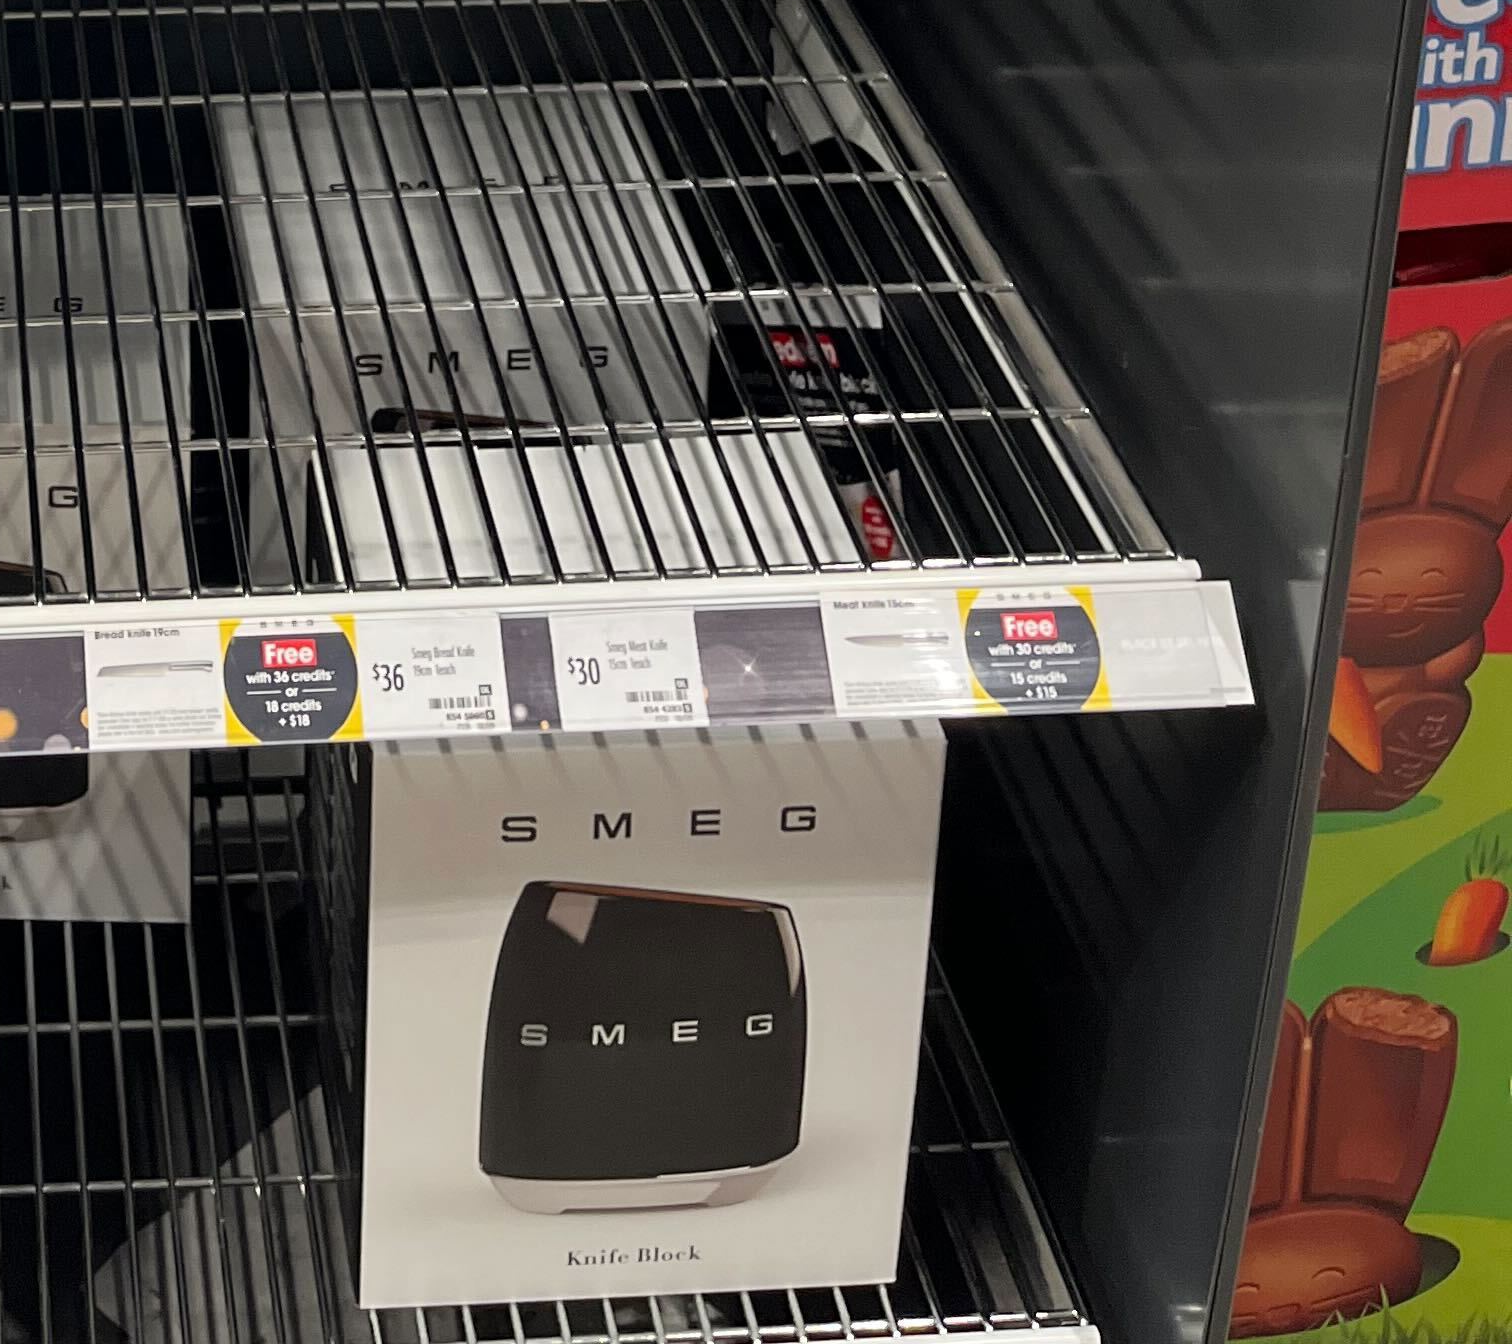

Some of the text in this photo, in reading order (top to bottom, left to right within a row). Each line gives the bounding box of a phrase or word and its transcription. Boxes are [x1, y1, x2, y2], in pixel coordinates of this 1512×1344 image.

[1423, 31, 1499, 85] ith
[94, 629, 125, 640] Bread
[126, 628, 152, 639] knife
[1004, 614, 1055, 638] Free
[264, 642, 315, 666] Free
[988, 644, 1015, 657] with
[1017, 644, 1031, 656] 30
[245, 672, 272, 685] with
[274, 671, 289, 683] 36
[372, 663, 404, 692] $36
[568, 657, 600, 685] $30
[1011, 671, 1067, 684] 15 credits
[265, 699, 322, 713] 18 credits
[289, 714, 311, 729] $18
[501, 805, 817, 843] SMEG
[520, 1013, 774, 1047] SMEG
[566, 1244, 702, 1267] Knife Block
